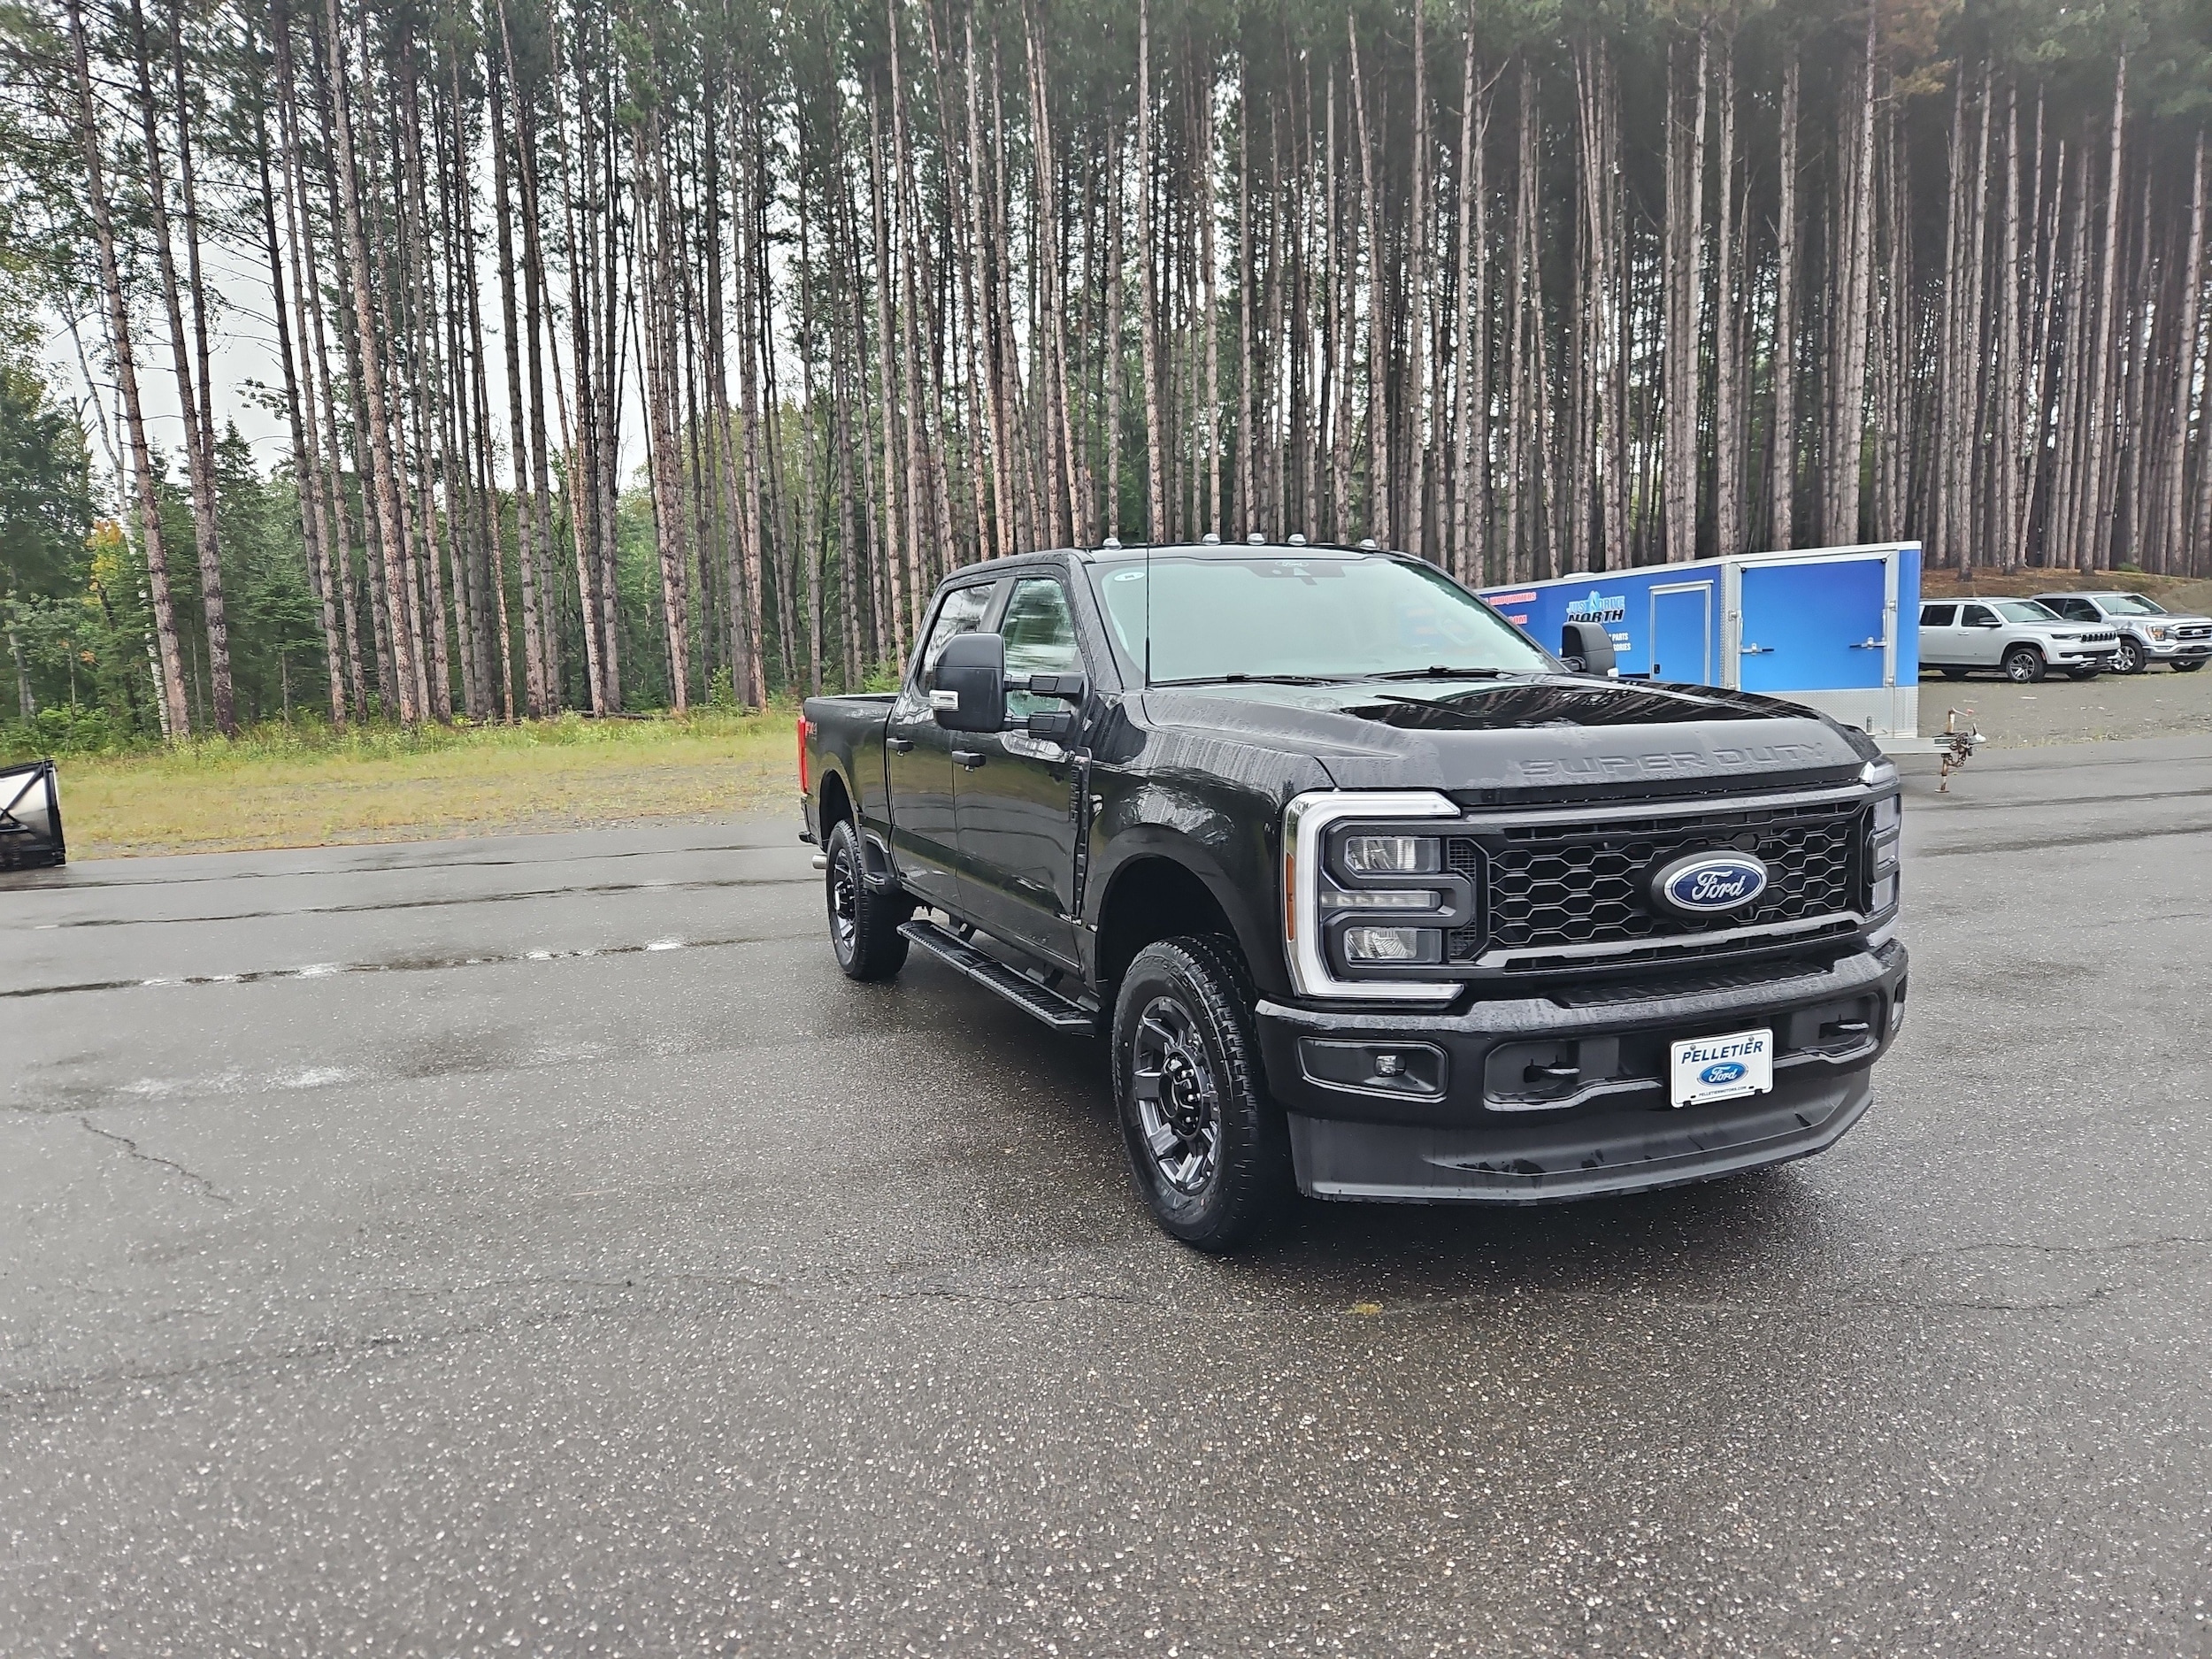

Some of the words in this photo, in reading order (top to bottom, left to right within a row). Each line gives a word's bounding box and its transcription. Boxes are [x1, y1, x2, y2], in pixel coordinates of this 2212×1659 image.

[1568, 609, 1624, 623] NORTH
[1611, 633, 1629, 641] PARTS
[1520, 751, 1708, 777] SUPER
[1712, 742, 1824, 766] DUTY
[1691, 870, 1747, 901] Ford
[1681, 1041, 1763, 1064] PELLETIER
[1709, 1065, 1738, 1082] Ford
